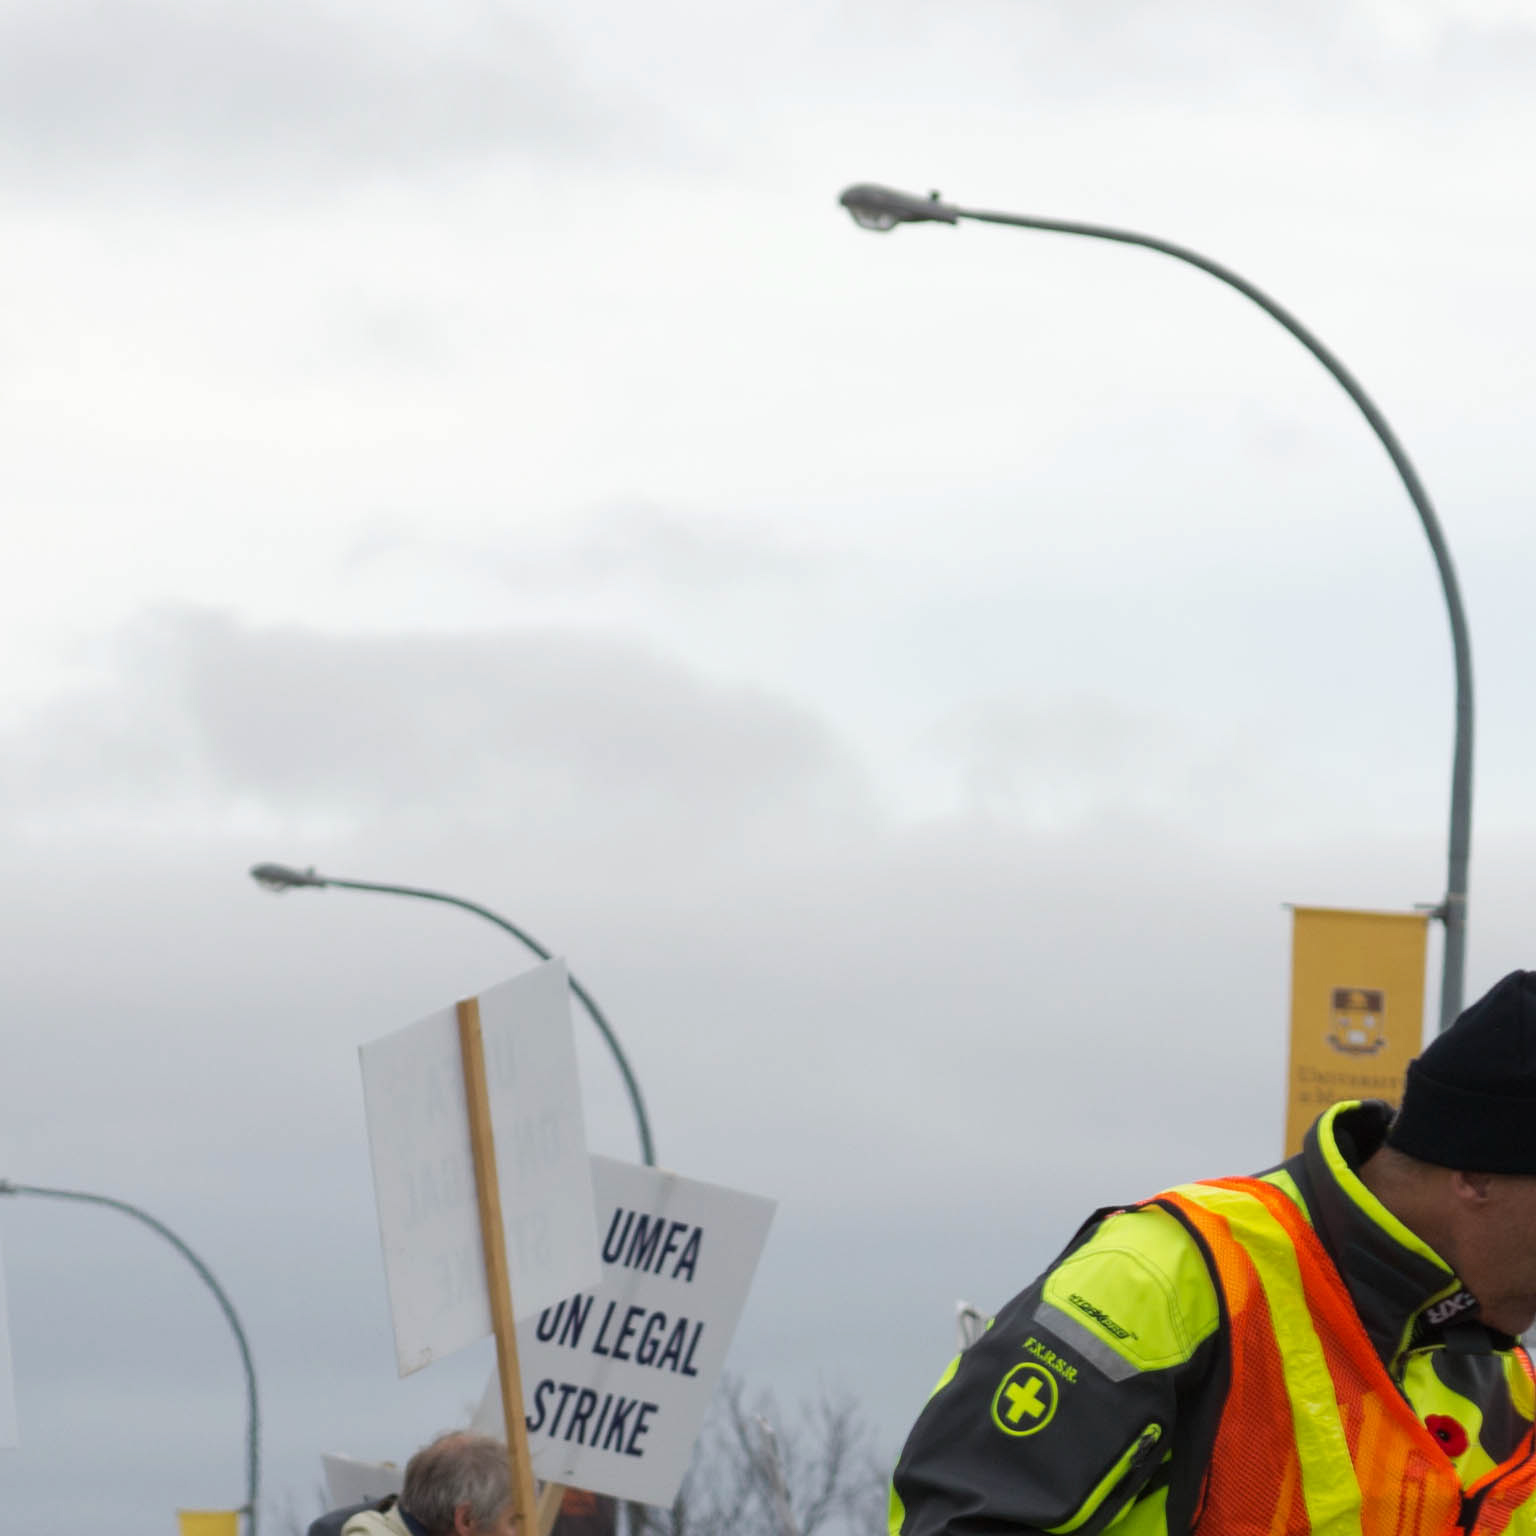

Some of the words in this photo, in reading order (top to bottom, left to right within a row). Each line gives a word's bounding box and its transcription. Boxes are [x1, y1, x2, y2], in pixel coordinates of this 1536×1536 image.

[601, 1207, 705, 1283] UMFA
[535, 1293, 595, 1350] ON
[592, 1300, 705, 1378] LEGAL
[525, 1378, 659, 1459] STRIKE
